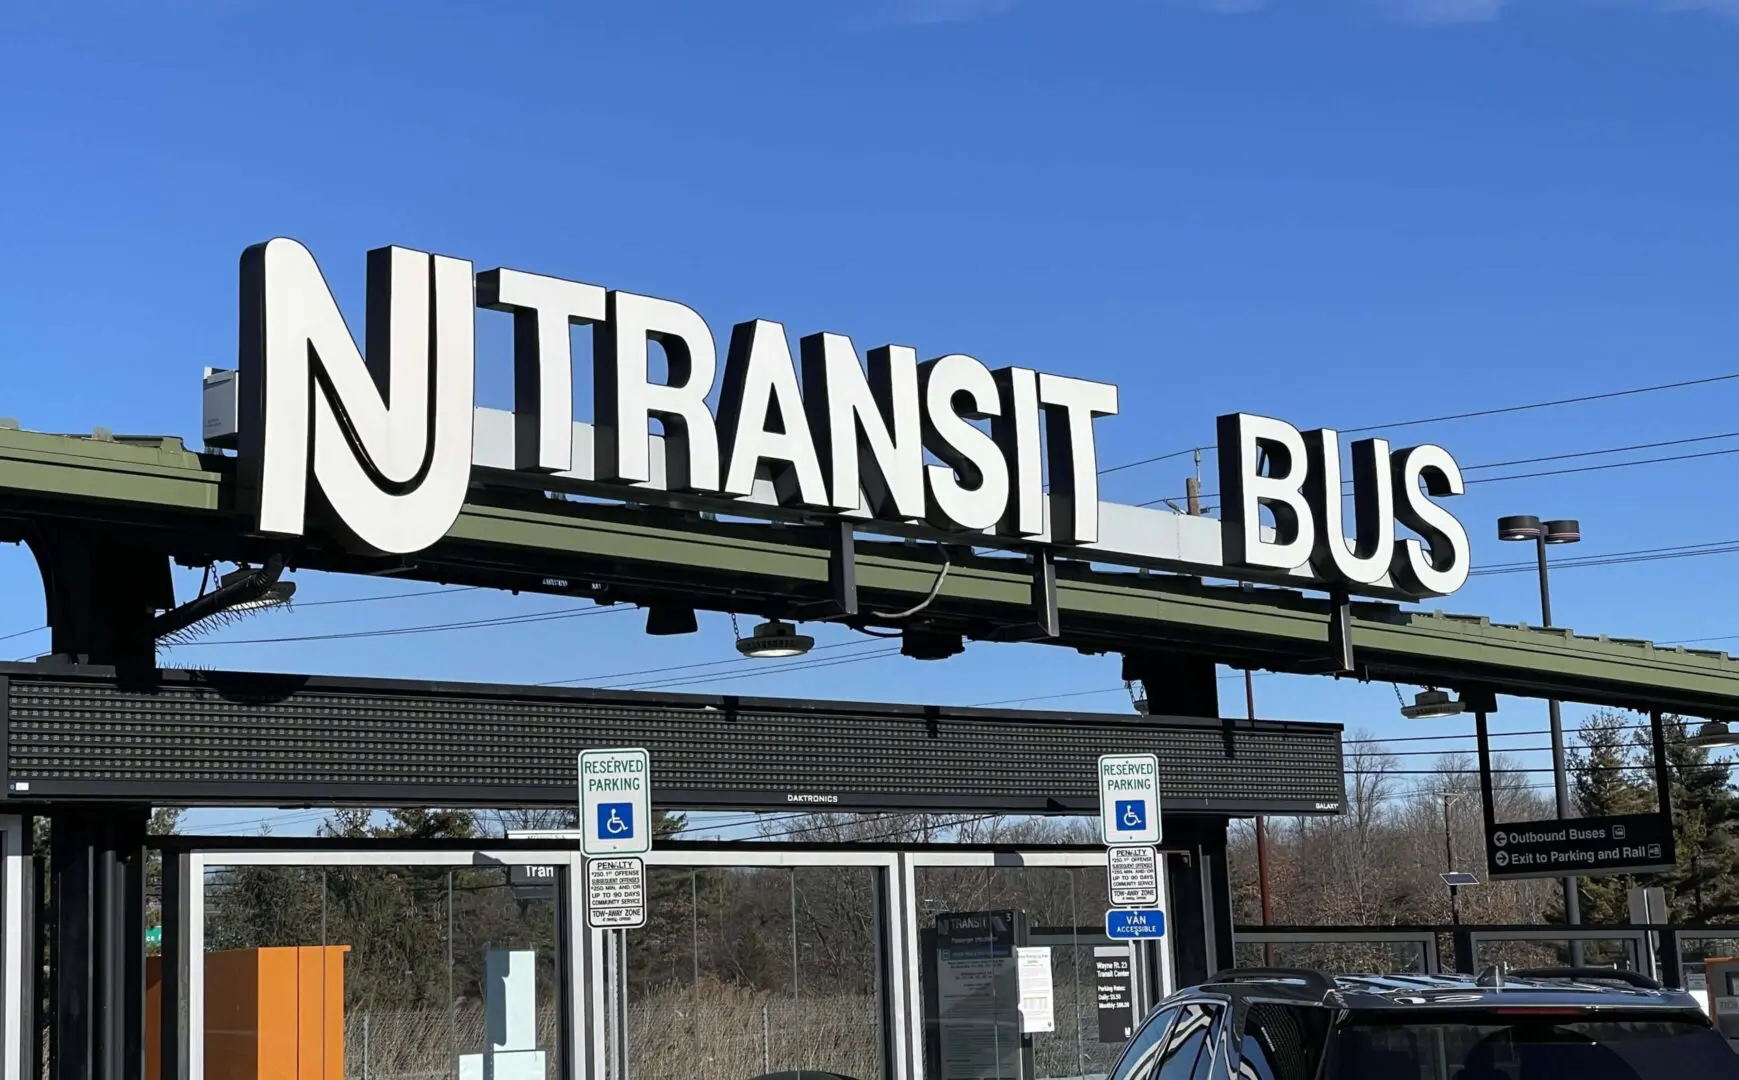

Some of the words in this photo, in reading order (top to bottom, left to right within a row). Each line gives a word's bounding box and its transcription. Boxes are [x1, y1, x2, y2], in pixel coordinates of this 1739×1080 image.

[240, 236, 474, 554] NJ
[476, 266, 1119, 545] TRANSIT
[1217, 411, 1471, 596] BUS
[584, 760, 644, 774] RESERVED
[1104, 764, 1154, 776] RESERVED
[589, 777, 640, 792] PARKING
[1108, 778, 1151, 790] PARKING
[788, 794, 838, 802] DAKTRONICS
[1510, 830, 1566, 844] Outbound
[1569, 828, 1606, 840] Buses
[1512, 852, 1534, 864] Exit
[1536, 853, 1548, 862] to
[1550, 850, 1594, 863] Parking
[1598, 848, 1620, 860] and
[1622, 846, 1646, 858] Rail
[624, 908, 640, 916] ZONE
[1126, 916, 1146, 924] VAN
